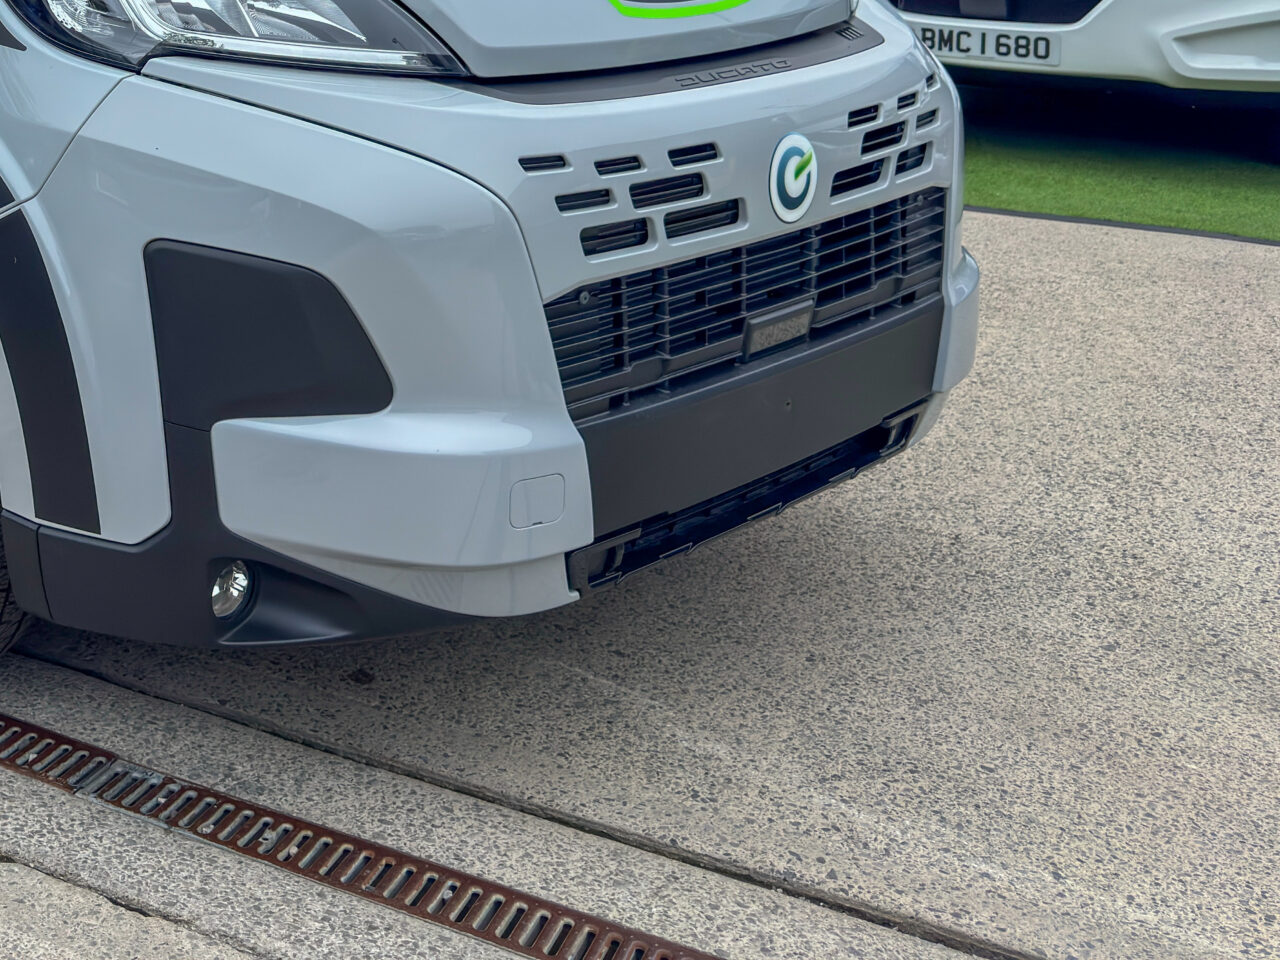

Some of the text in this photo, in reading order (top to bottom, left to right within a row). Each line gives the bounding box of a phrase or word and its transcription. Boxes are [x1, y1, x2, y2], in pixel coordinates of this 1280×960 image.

[921, 27, 972, 54] BMC
[995, 34, 1051, 60] 680
[674, 59, 793, 88] DUCATO
